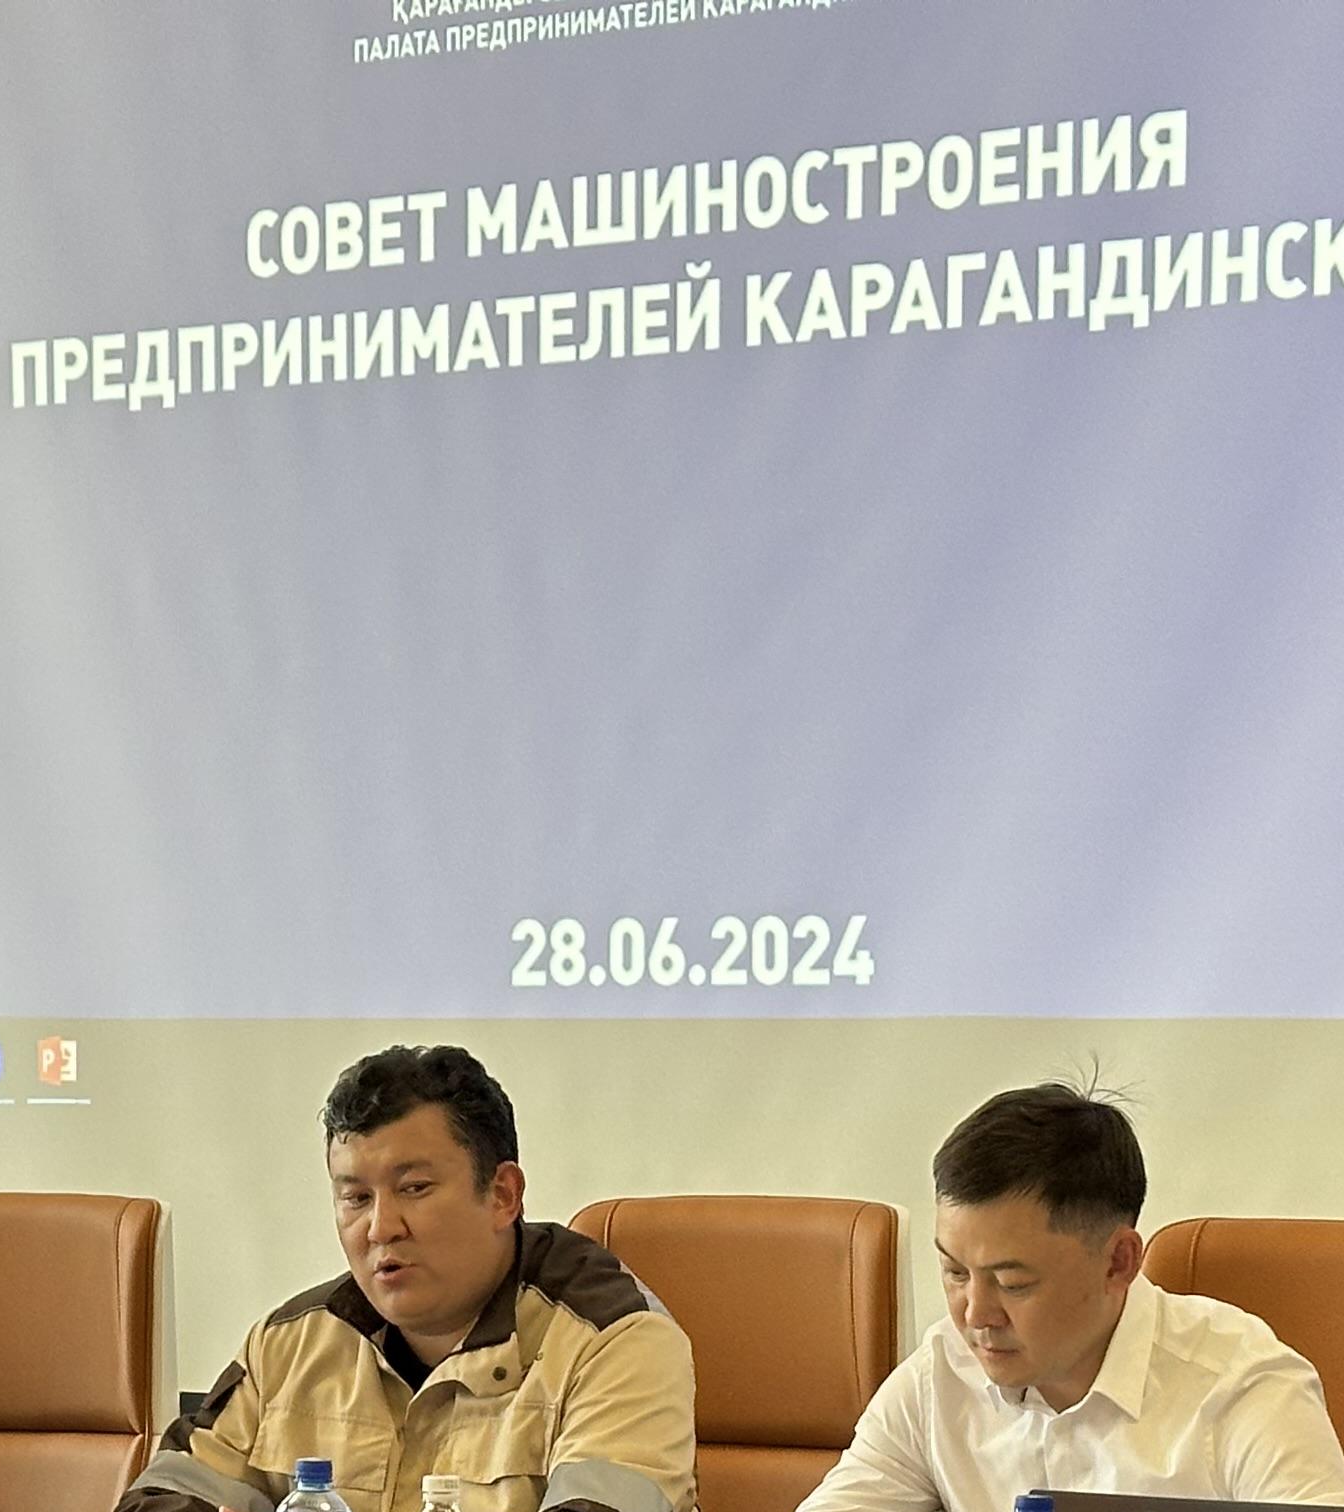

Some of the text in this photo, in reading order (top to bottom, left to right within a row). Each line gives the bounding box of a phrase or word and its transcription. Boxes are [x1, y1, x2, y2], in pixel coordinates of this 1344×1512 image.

[354, 30, 440, 63] ПАЛАТА
[446, 0, 696, 51] ПРЕДПРИНИМАТЕЛЕЙ
[247, 109, 1188, 279] СОВЕТ МАШИНОСТРОЕНИЯ
[10, 260, 721, 412] ПРЕДПРИНИМАТЕЛЕЙ
[511, 914, 875, 987] 28.06.2024
